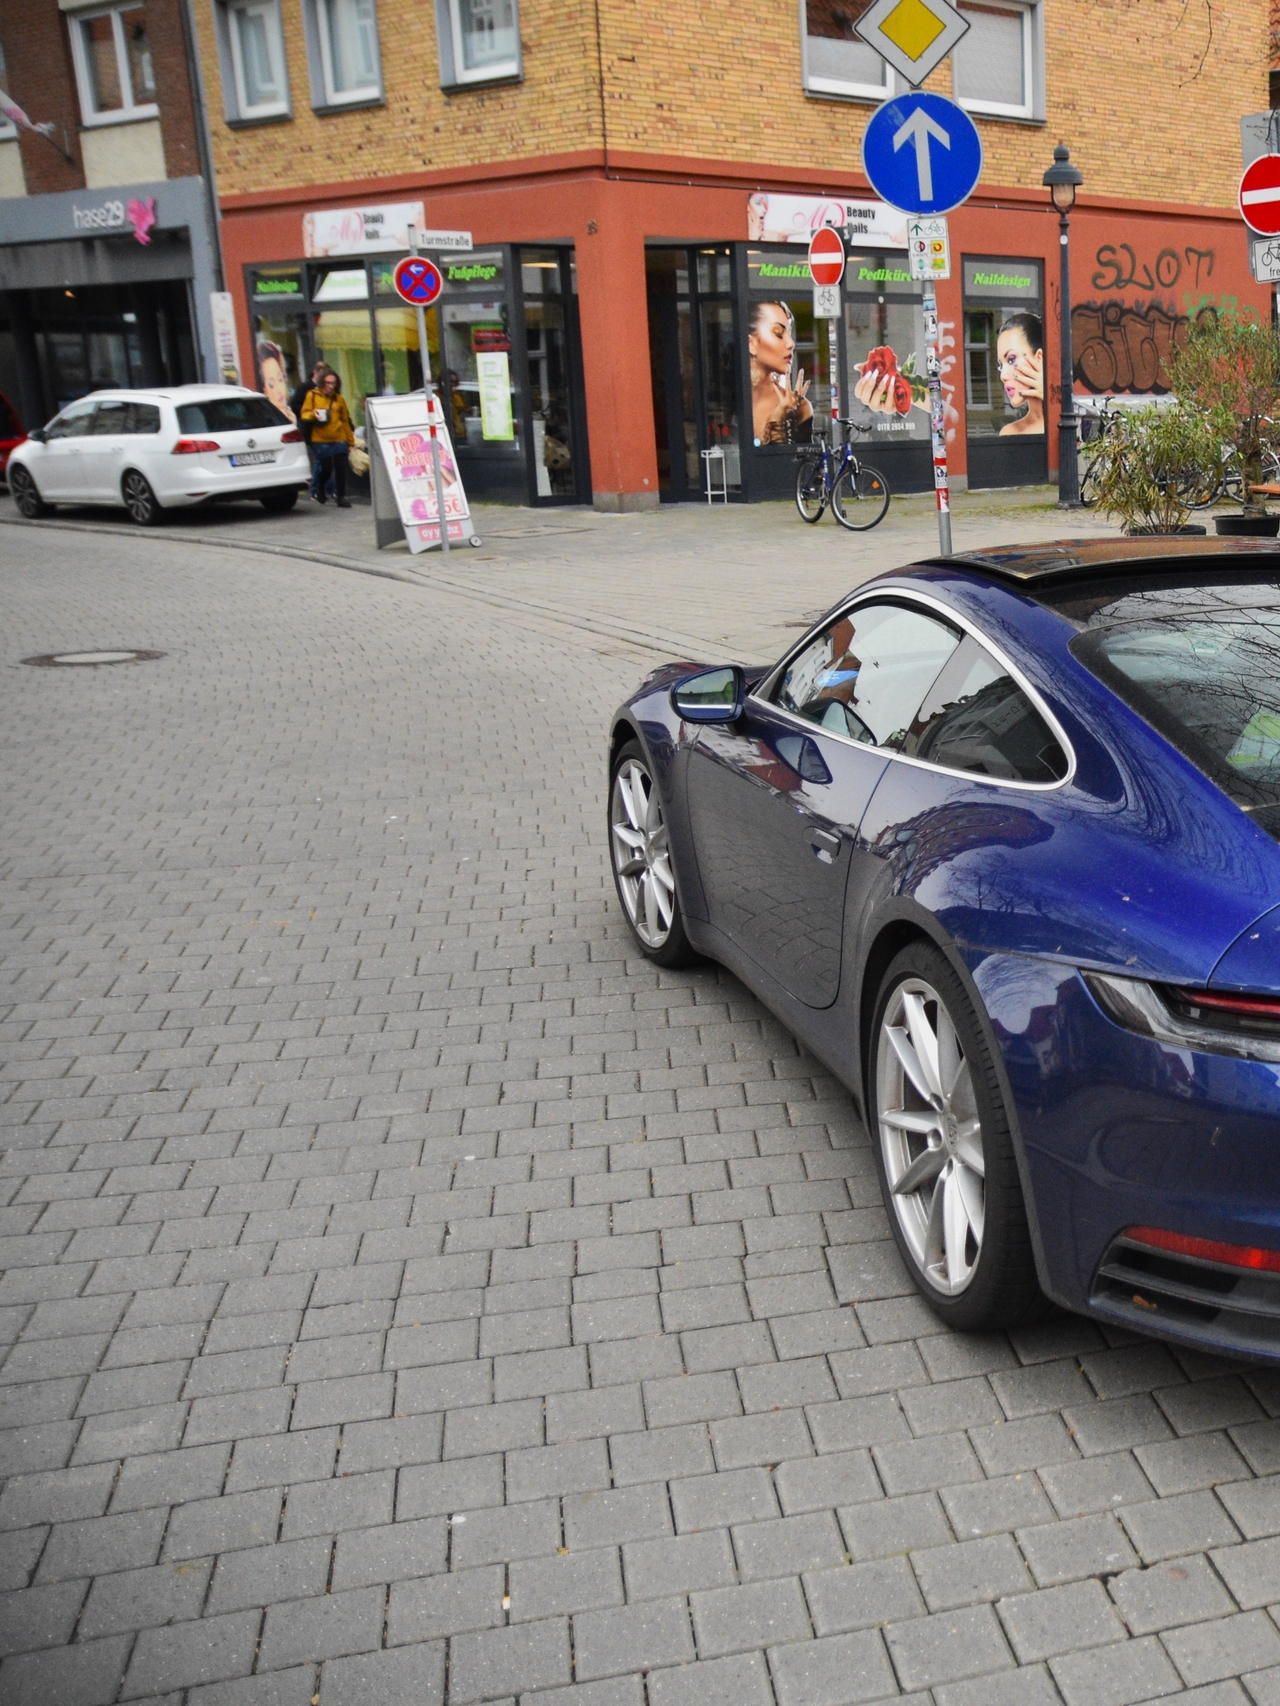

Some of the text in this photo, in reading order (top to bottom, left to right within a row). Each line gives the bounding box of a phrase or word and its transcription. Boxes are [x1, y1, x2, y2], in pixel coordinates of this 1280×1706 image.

[72, 200, 125, 229] hase29
[846, 206, 876, 219] Beauty
[421, 234, 470, 246] Turmstraße
[447, 264, 497, 281] Fußpflege
[758, 263, 813, 278] Manikü
[973, 272, 1031, 289] Naildesign
[389, 437, 420, 454] TOP
